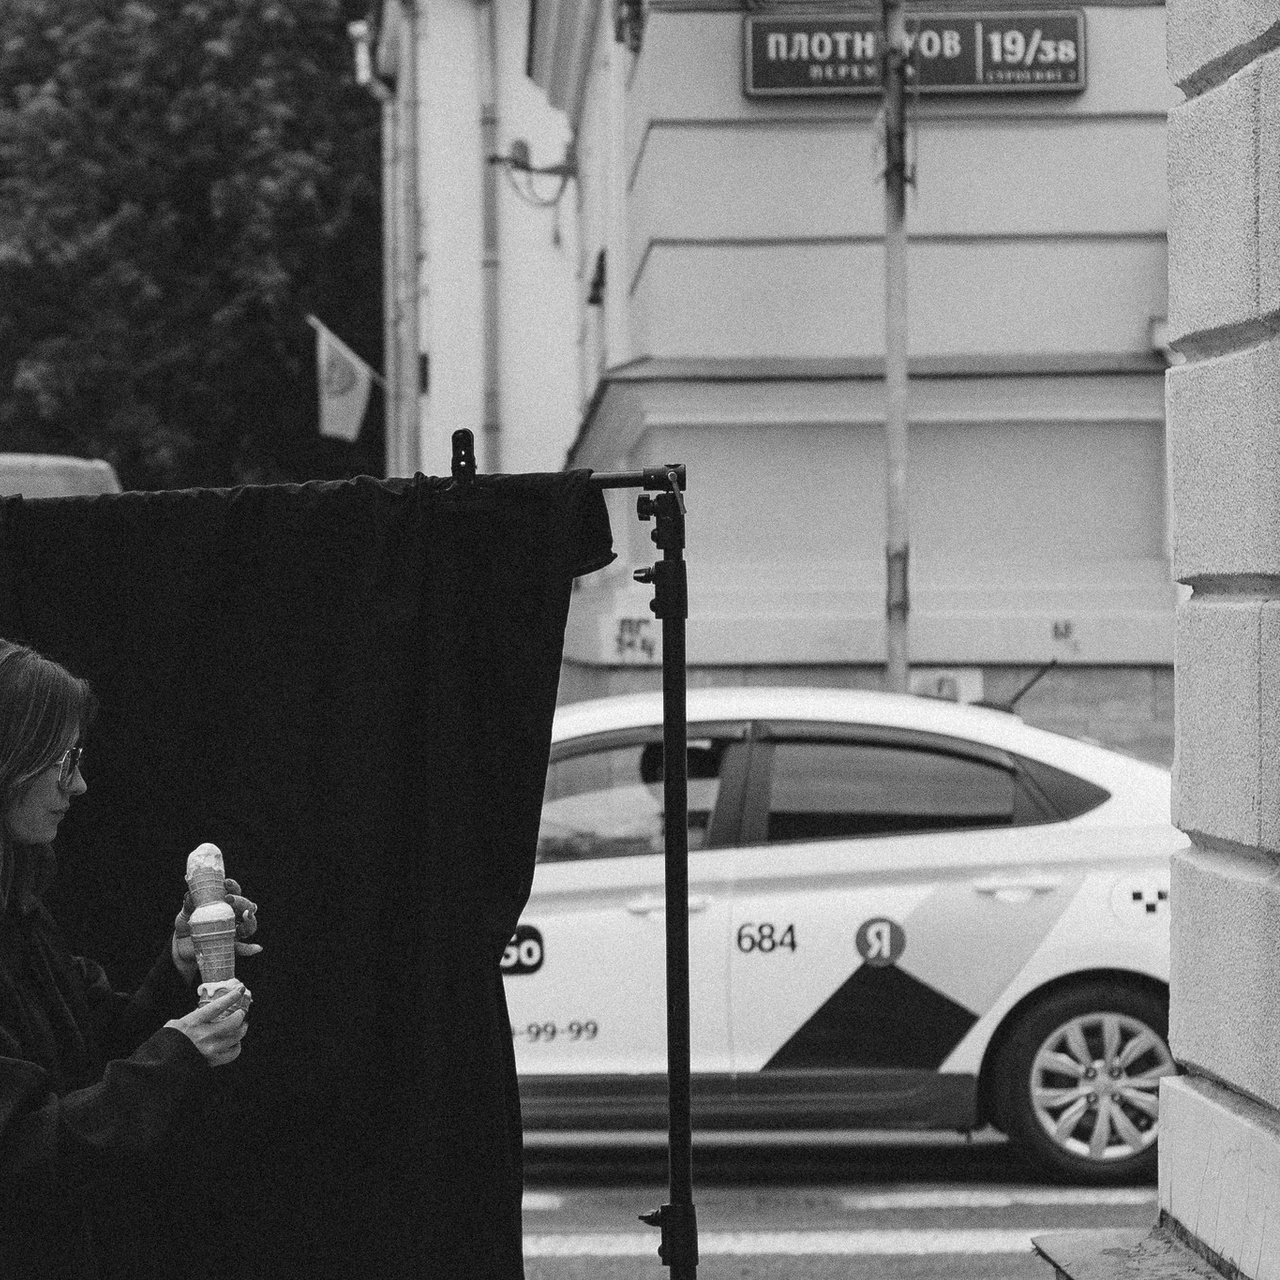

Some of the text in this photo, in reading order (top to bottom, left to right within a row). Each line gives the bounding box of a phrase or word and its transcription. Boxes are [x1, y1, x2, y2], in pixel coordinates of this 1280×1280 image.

[769, 30, 962, 61] ПЛОТНОВ
[736, 922, 798, 954] 684
[865, 921, 891, 959] Я
[511, 1019, 599, 1044] -99-99
